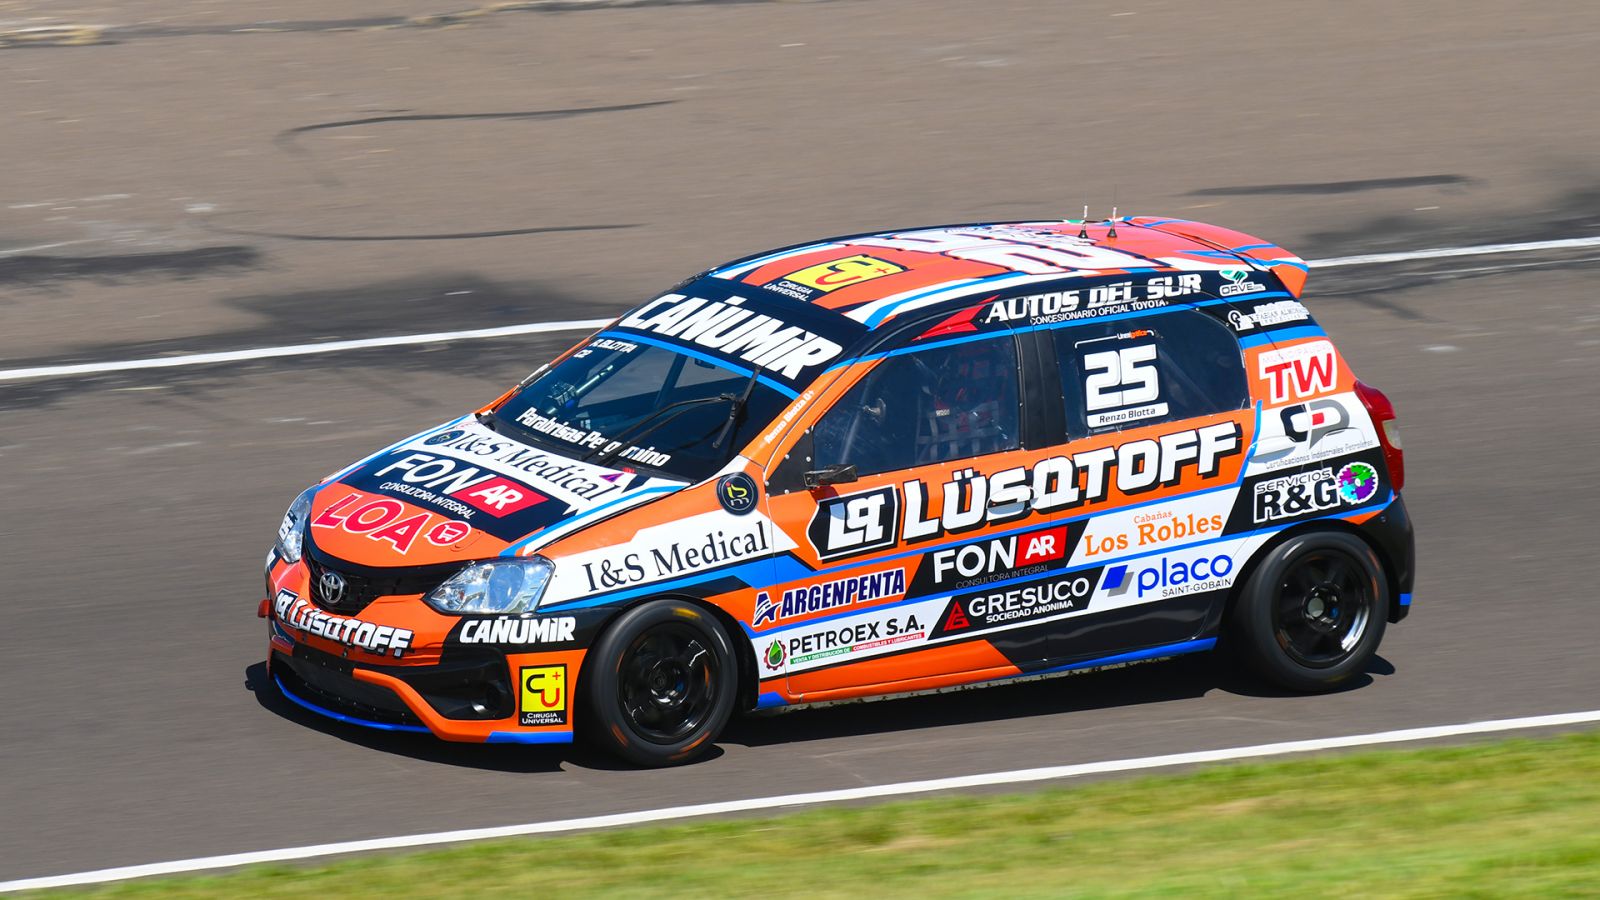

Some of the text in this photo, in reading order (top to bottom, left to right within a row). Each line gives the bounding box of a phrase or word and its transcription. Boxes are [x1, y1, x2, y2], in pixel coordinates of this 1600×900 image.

[763, 283, 809, 302] UNIVERSAL
[778, 281, 812, 295] CIRUGIA
[985, 273, 1202, 324] AUTOS DEL SUR
[1221, 283, 1253, 295] ORVE
[1030, 299, 1166, 326] CONCESIONARIO OFICIAL TOYOTA
[1084, 344, 1159, 411] 25
[1264, 353, 1332, 398] TW
[515, 407, 582, 444] Parabrisas
[1099, 407, 1156, 423] Renzo Blotta
[448, 432, 621, 501] I&S Medical
[1256, 470, 1331, 493] SERVICIOS
[379, 481, 476, 519] CONSULTORA INTEGRAL
[1133, 511, 1172, 524] Cabañas
[1256, 478, 1338, 520] R&G
[310, 493, 432, 555] LOA
[1085, 513, 1223, 556] Los Robles
[582, 521, 769, 592] I&S Medical
[781, 569, 905, 618] ARGENPENTA
[955, 564, 1049, 589] CONSULTORA INTEGRAL
[1138, 554, 1233, 598] placo
[1162, 578, 1232, 598] SAINT-GOBAIN
[968, 577, 1090, 617] GRESUCO
[986, 600, 1073, 624] SOCIEDAD ANONIMA
[790, 614, 925, 656] PETROEX S.A.
[793, 655, 808, 664] VENTA
[853, 640, 887, 651] COMBUSTIBLES
[891, 633, 922, 644] LUBRICANTES
[522, 717, 564, 725] UNIVERSAL
